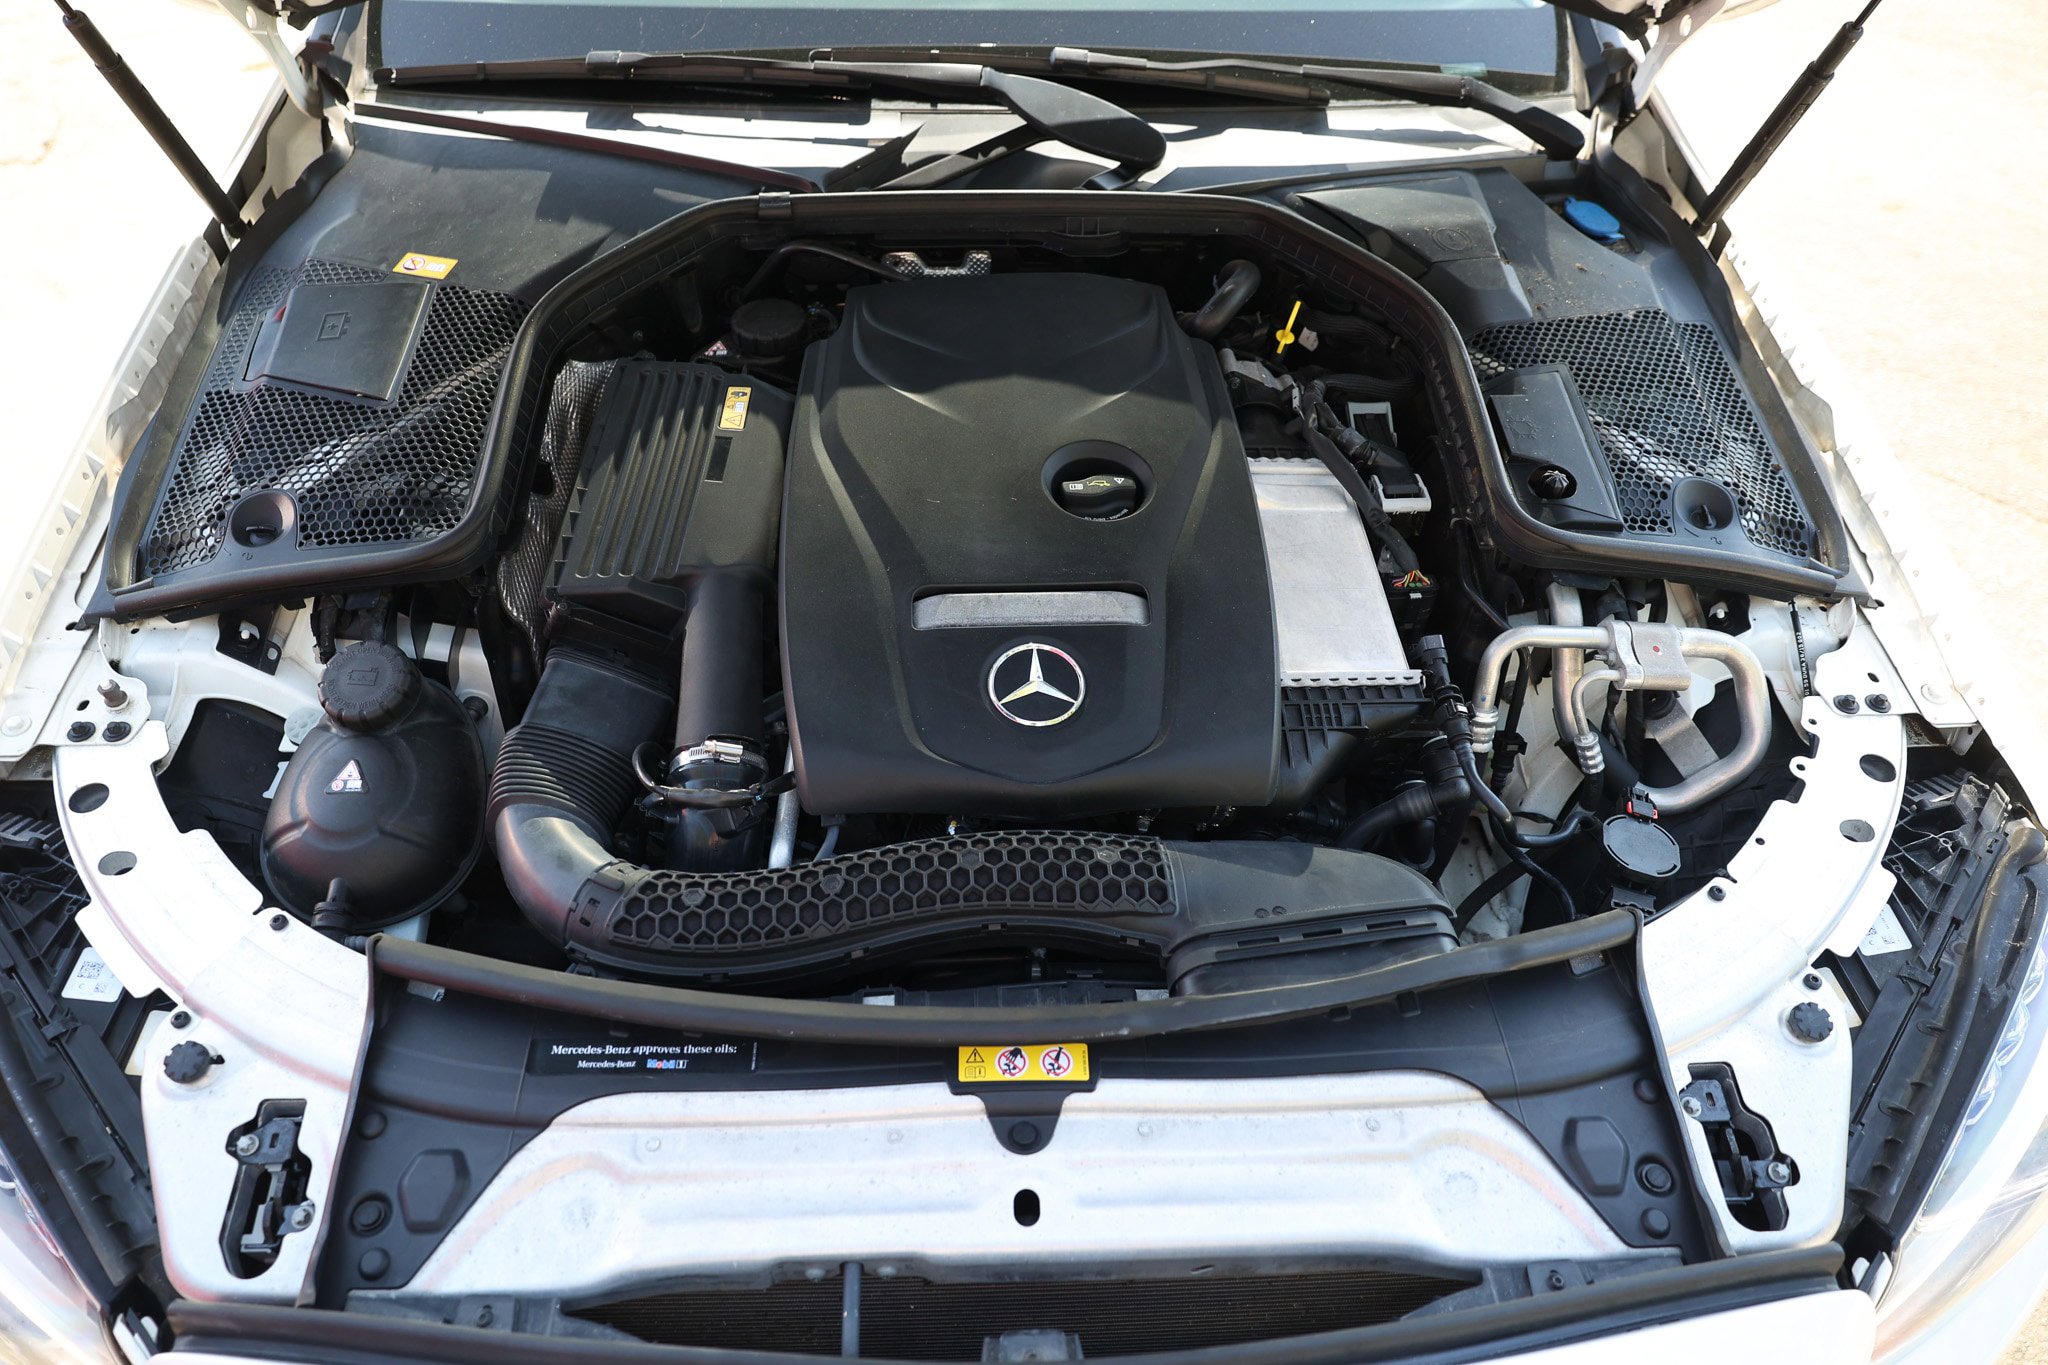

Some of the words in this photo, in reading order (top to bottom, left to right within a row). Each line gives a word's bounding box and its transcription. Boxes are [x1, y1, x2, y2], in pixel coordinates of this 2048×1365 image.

[551, 1045, 631, 1055] Mercedes-Benz
[633, 1046, 681, 1056] approves
[683, 1045, 712, 1054] these
[714, 1044, 737, 1054] oils:
[577, 1060, 636, 1069] Mercedes-Benz
[646, 1059, 676, 1069] Mobil
